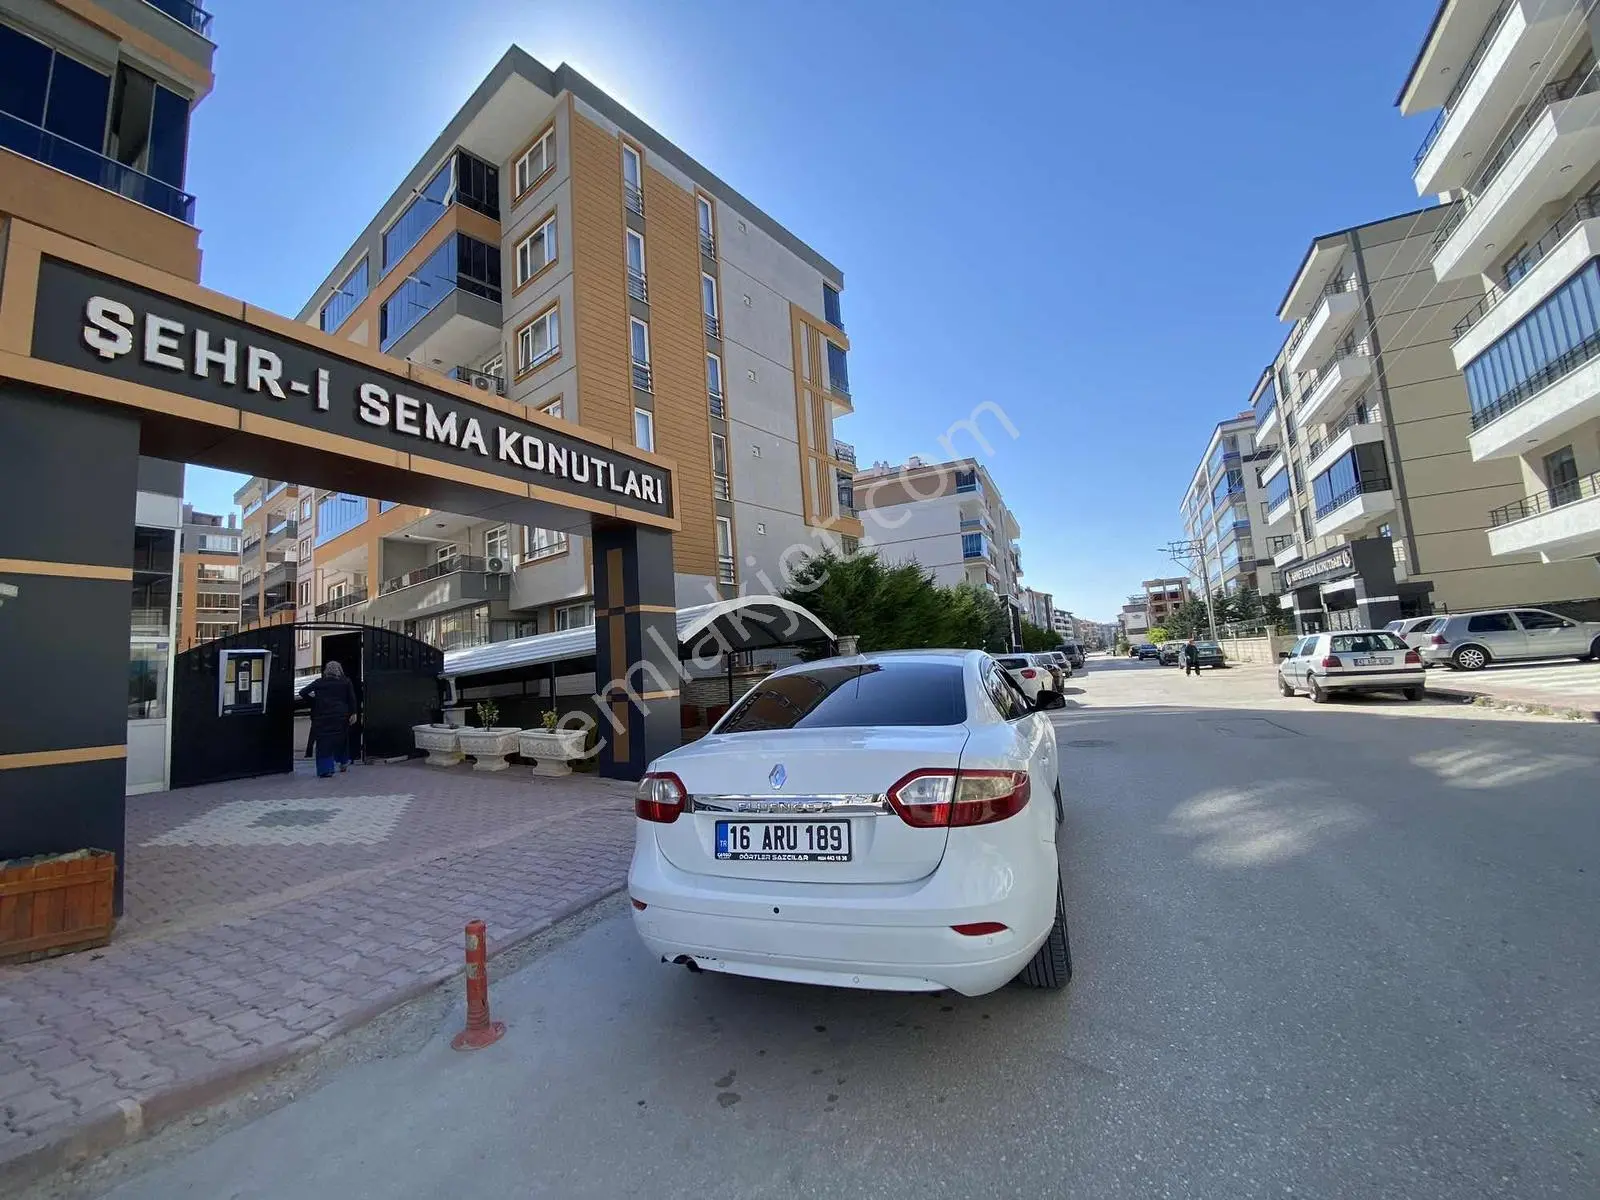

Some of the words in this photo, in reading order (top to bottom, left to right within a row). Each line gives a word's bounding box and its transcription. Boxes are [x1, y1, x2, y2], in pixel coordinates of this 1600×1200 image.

[83, 295, 330, 411] ŞEHR-İ
[359, 382, 489, 456] SEMA
[497, 425, 664, 504] KONUTLARI
[719, 840, 728, 848] TR
[729, 825, 751, 850] 16
[761, 825, 798, 851] ARU
[805, 825, 842, 851] 189
